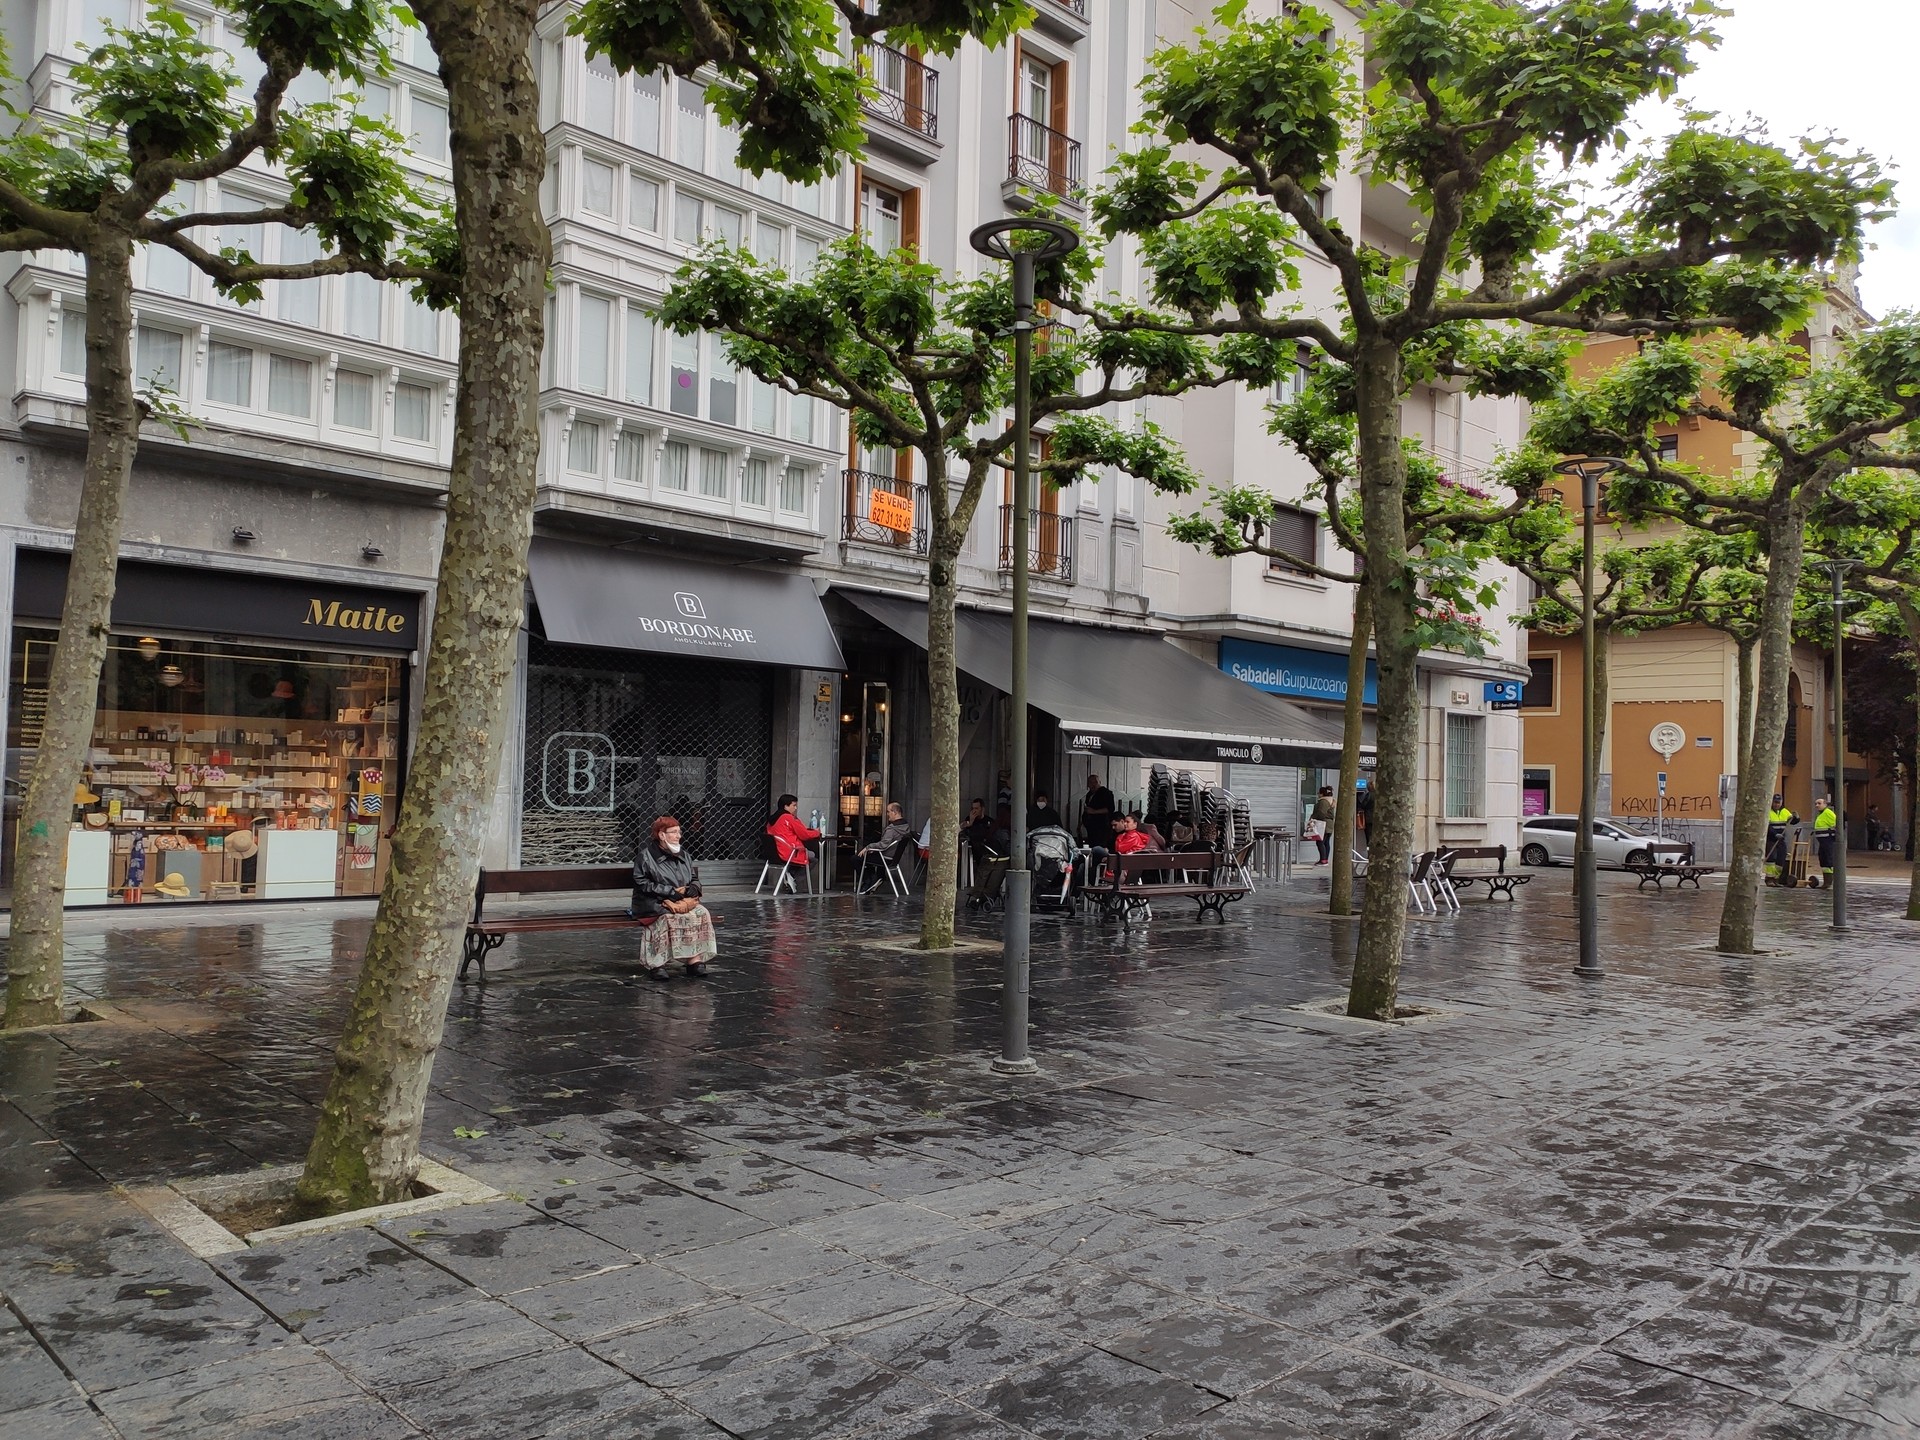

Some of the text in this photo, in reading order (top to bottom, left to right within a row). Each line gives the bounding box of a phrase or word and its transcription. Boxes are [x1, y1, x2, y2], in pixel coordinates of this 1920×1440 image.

[874, 492, 912, 512] SE VENDE
[872, 507, 884, 522] 627
[886, 511, 893, 525] 31
[895, 513, 902, 528] 35
[681, 597, 697, 613] B
[301, 599, 405, 633] Maite
[638, 617, 757, 643] BORDONABE
[674, 637, 733, 648] AHOLKULARITZA
[1505, 685, 1517, 700] S
[1072, 735, 1101, 746] AMSTEL
[1216, 747, 1249, 758] TRIANGULO
[564, 748, 596, 794] B
[1621, 796, 1712, 812] KAXILDA ETA
